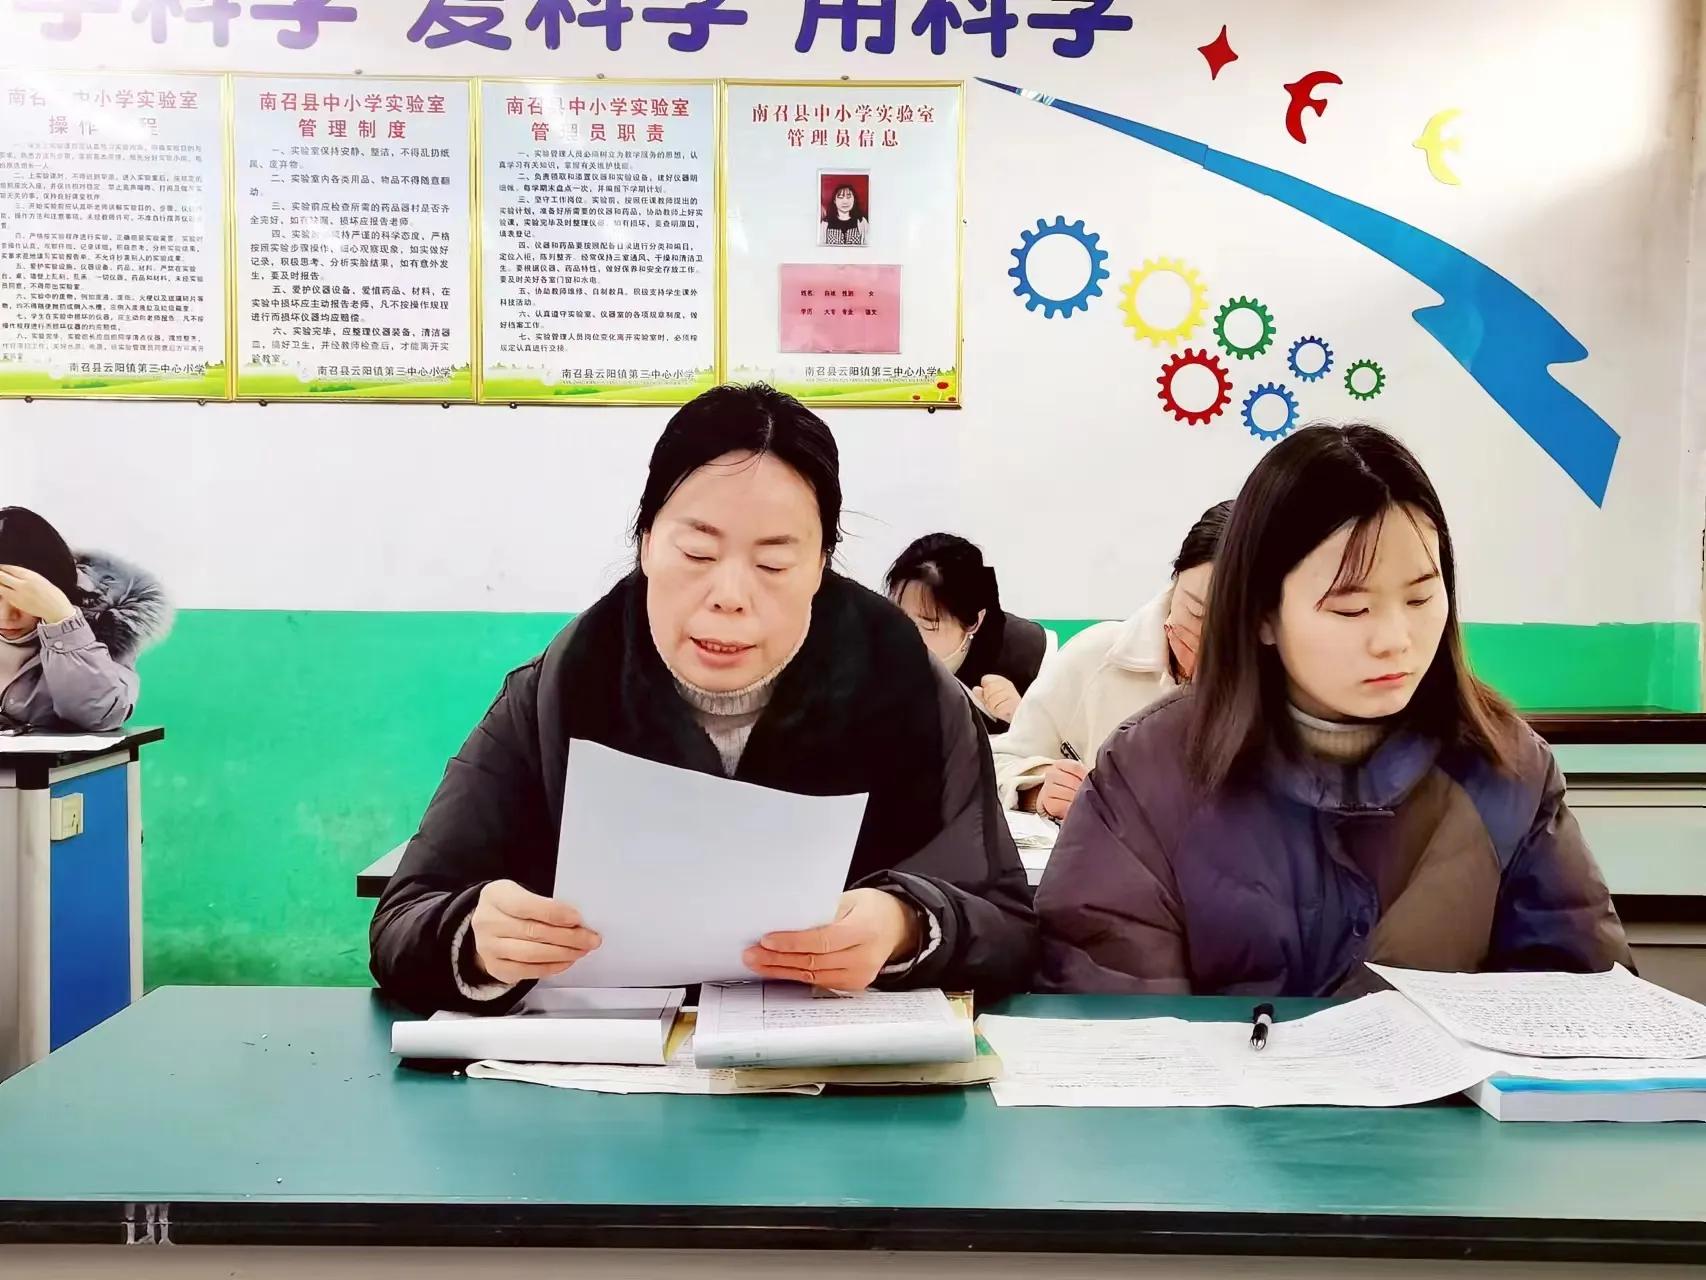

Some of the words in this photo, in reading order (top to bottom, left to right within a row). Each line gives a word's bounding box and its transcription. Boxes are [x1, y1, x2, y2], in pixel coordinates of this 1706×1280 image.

[8, 89, 198, 109] 南召中小学实验室
[260, 92, 445, 114] 南召县中小学实验室
[752, 104, 934, 124] 南召县中小学实验室
[298, 118, 406, 139] 管理制度
[788, 129, 898, 148] 管理员信息
[70, 362, 205, 374] 南召县云阳镇第三中心小学
[317, 365, 451, 377] 南召县云阳镇第三中心小学
[562, 368, 695, 380] 南召县云阳镇第三中心小学
[805, 366, 938, 377] 南召县云阳镇第三中心小学
